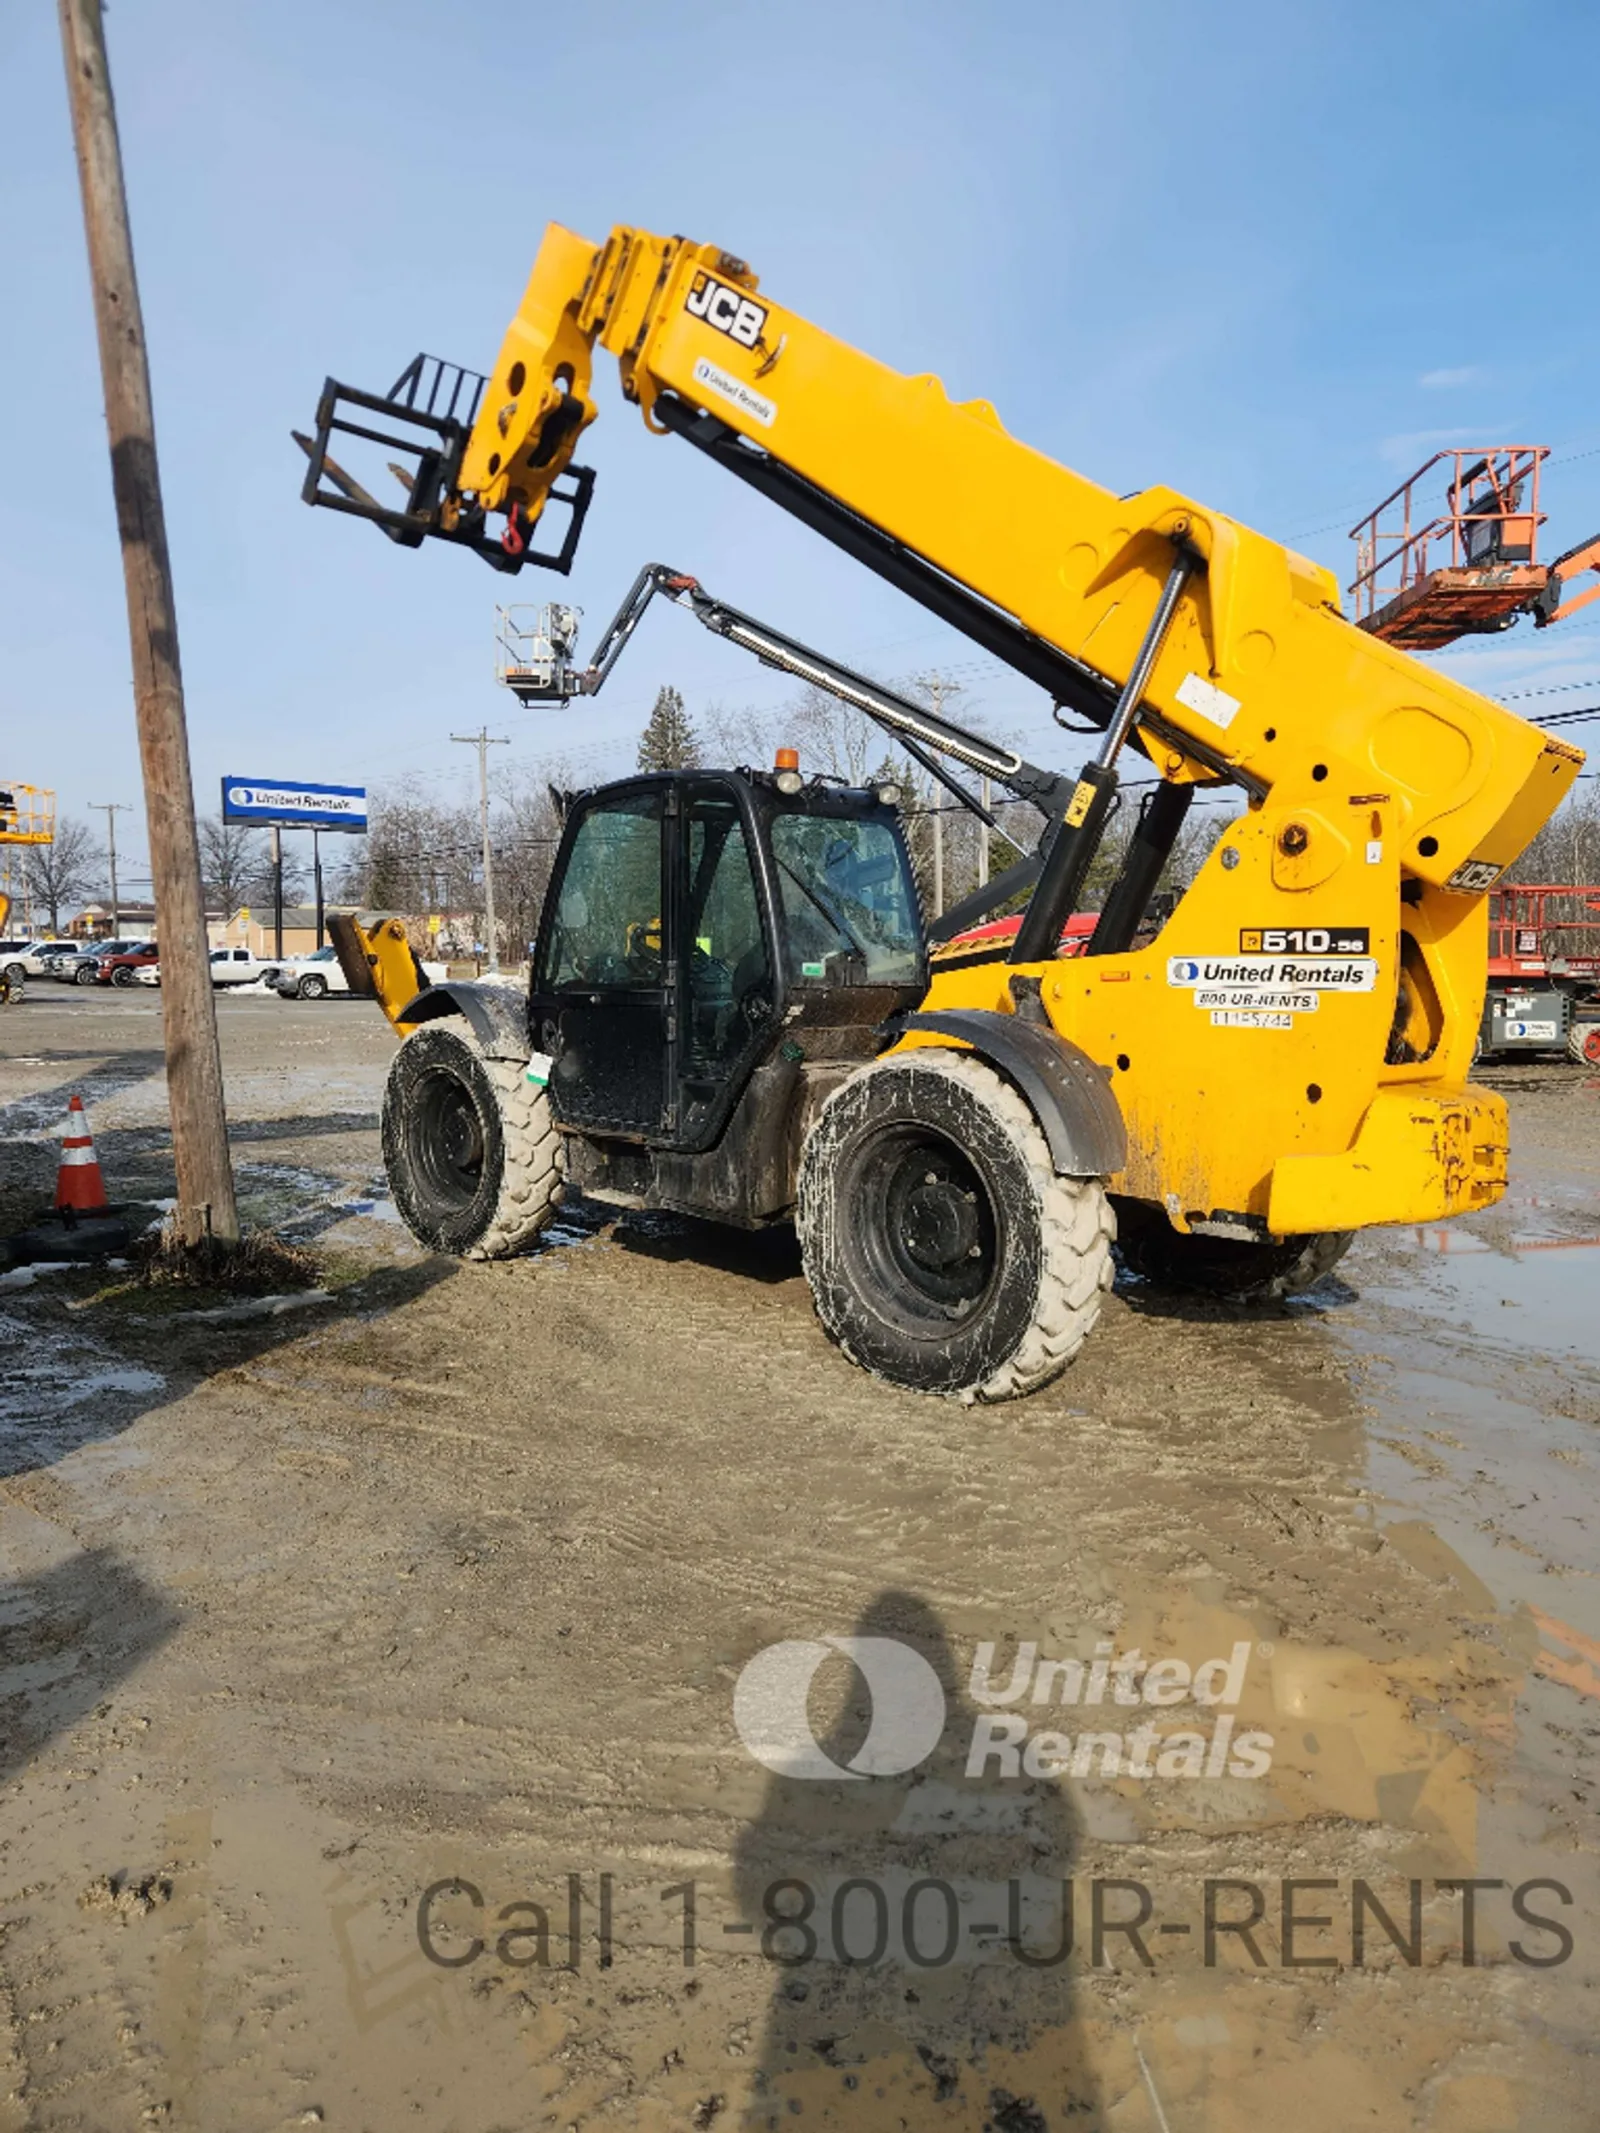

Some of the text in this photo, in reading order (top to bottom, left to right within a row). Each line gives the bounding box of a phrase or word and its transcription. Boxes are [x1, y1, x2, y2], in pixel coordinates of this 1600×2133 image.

[687, 280, 765, 346] JCB
[709, 371, 770, 419] United Rentals
[256, 793, 351, 810] United Rentals
[1451, 863, 1500, 890] JCB
[1204, 964, 1364, 984] United Rentals
